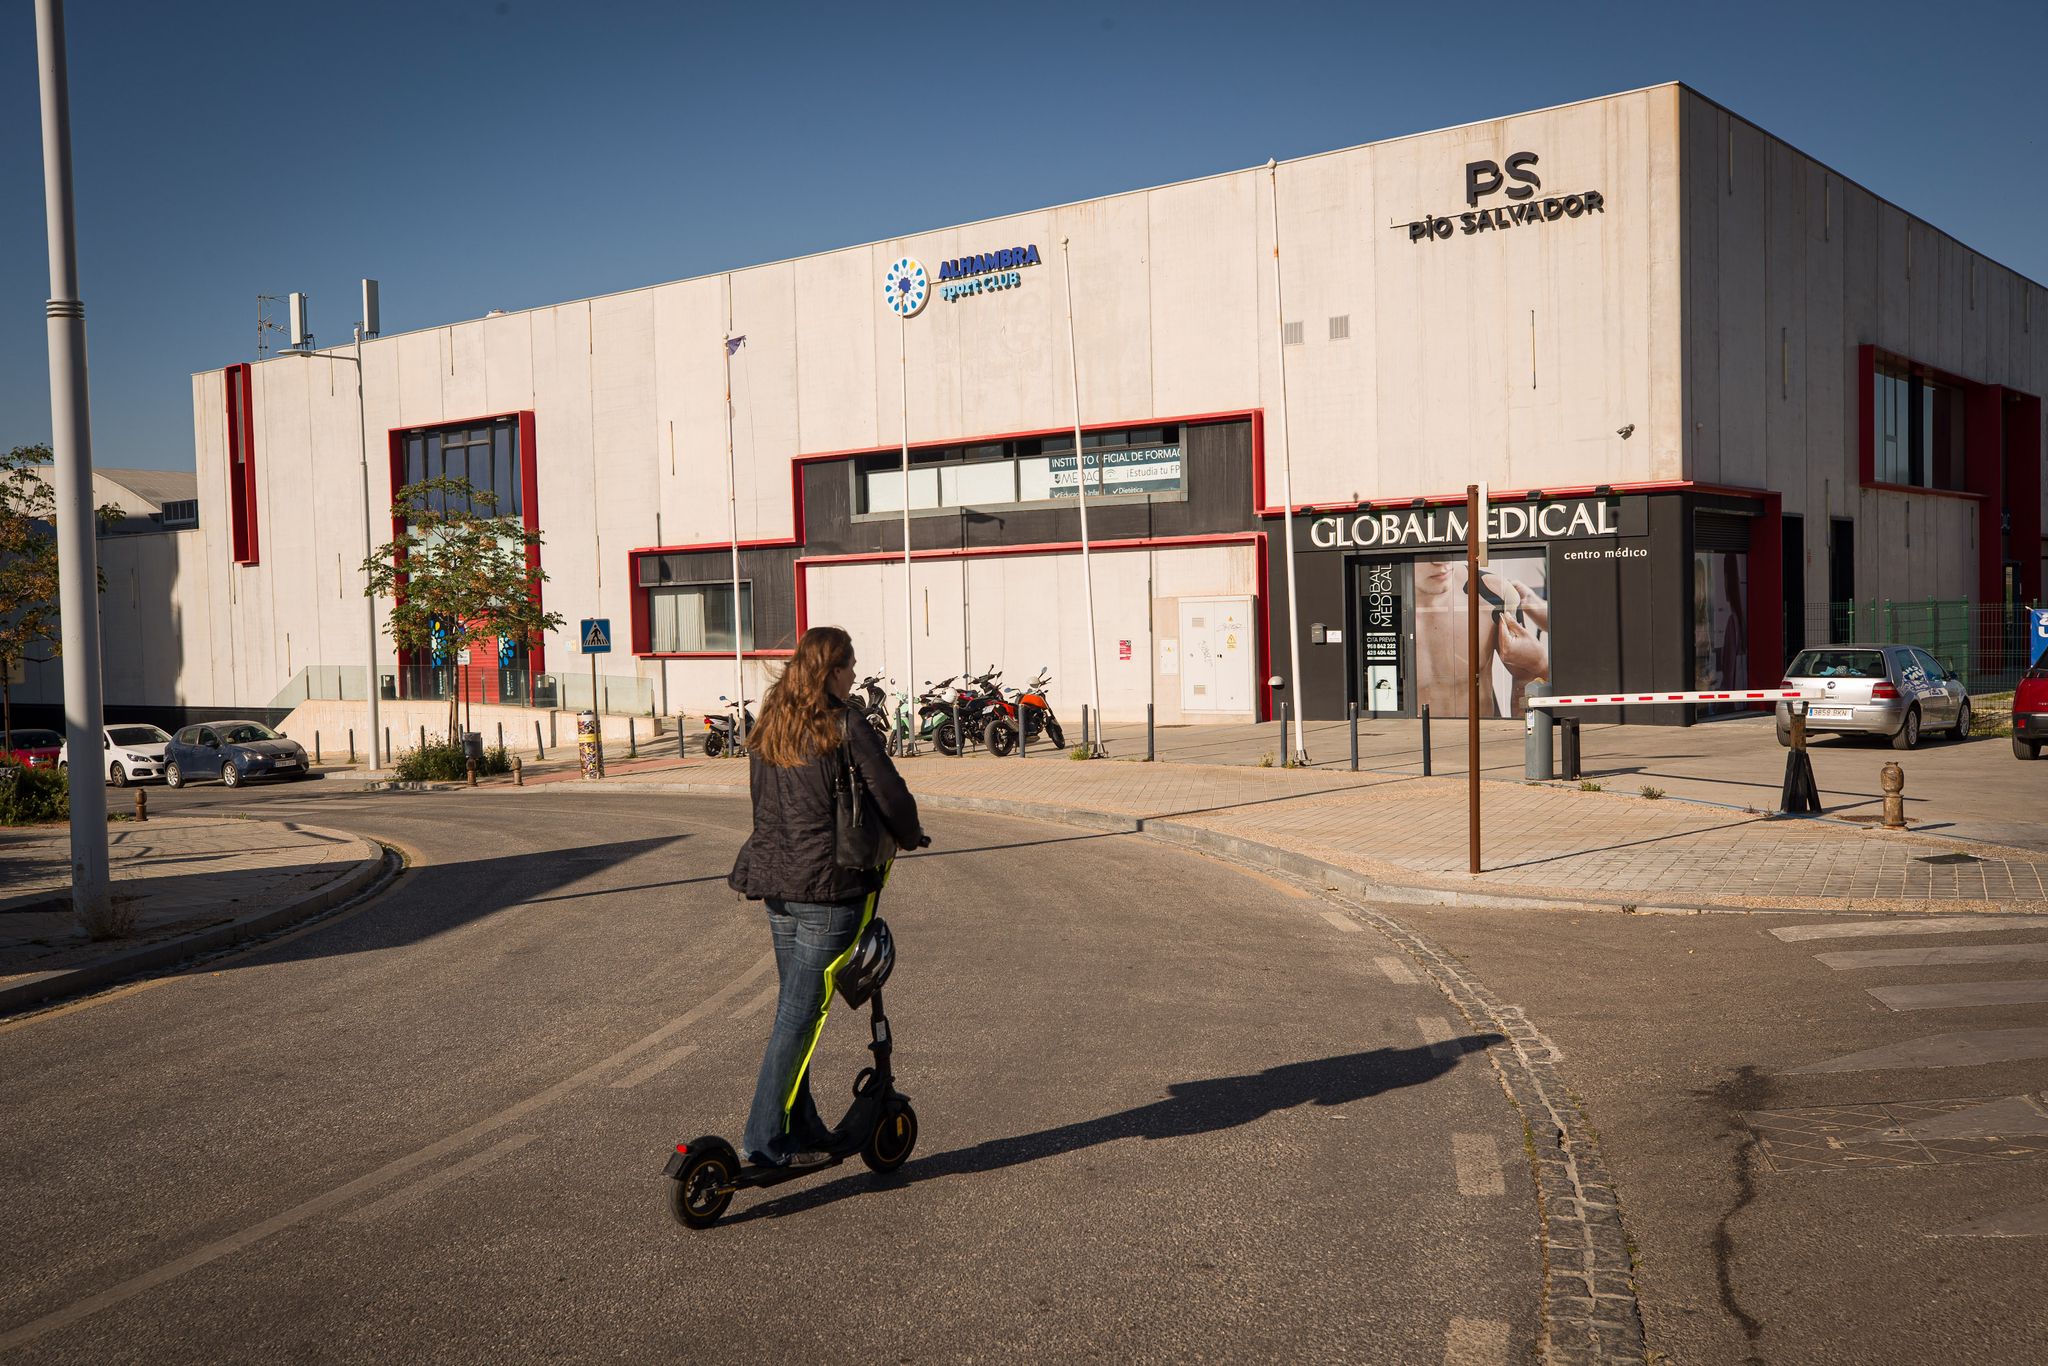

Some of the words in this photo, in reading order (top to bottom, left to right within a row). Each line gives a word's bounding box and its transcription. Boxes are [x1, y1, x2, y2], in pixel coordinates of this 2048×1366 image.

[1466, 151, 1541, 208] PS
[1460, 190, 1605, 236] SALVADOR
[939, 244, 1042, 279] ALHAMBRA
[983, 271, 1021, 293] CLUB
[1051, 455, 1095, 468] INSTITTO
[1131, 451, 1143, 461] DE
[1160, 467, 1168, 475] tu
[1564, 550, 1601, 561] centro
[1369, 566, 1381, 625] GLOBAL
[1381, 562, 1392, 627] MEDICAL
